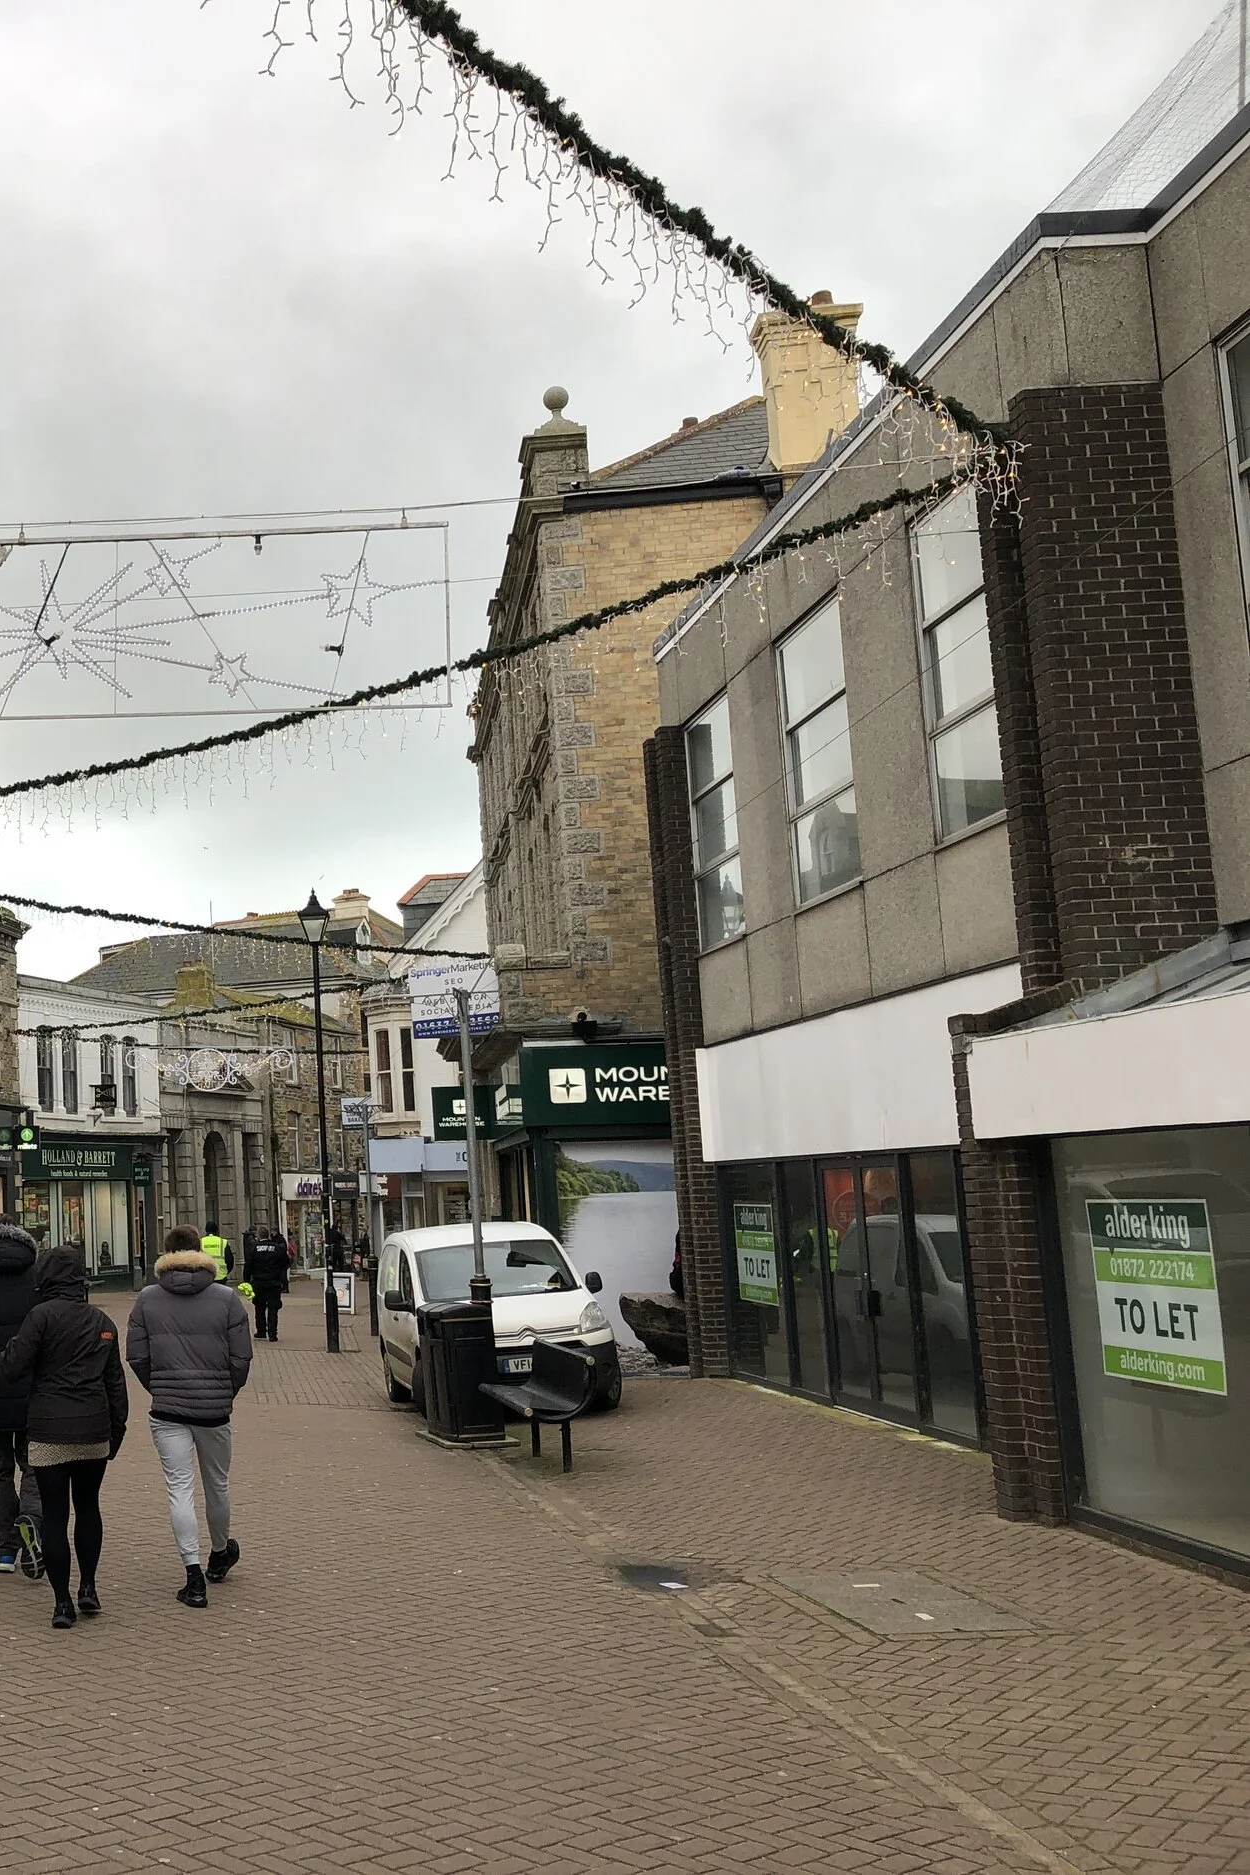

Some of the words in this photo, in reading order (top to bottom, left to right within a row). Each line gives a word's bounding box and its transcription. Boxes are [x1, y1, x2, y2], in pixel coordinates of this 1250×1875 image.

[444, 977, 463, 985] SEO
[421, 1007, 456, 1016] SOCIAL
[467, 1003, 493, 1012] EDIA
[594, 1085, 671, 1102] WARE
[41, 1149, 76, 1166] HOLLAND
[76, 1150, 83, 1166] &
[84, 1151, 116, 1167] BARRETT
[744, 1257, 754, 1276] TO
[756, 1258, 770, 1279] LET
[1110, 1257, 1146, 1278] 01872
[1149, 1259, 1195, 1281] 222174
[1114, 1297, 1146, 1335] TO
[1152, 1300, 1199, 1341] LET
[1120, 1350, 1206, 1382] alderking.com
